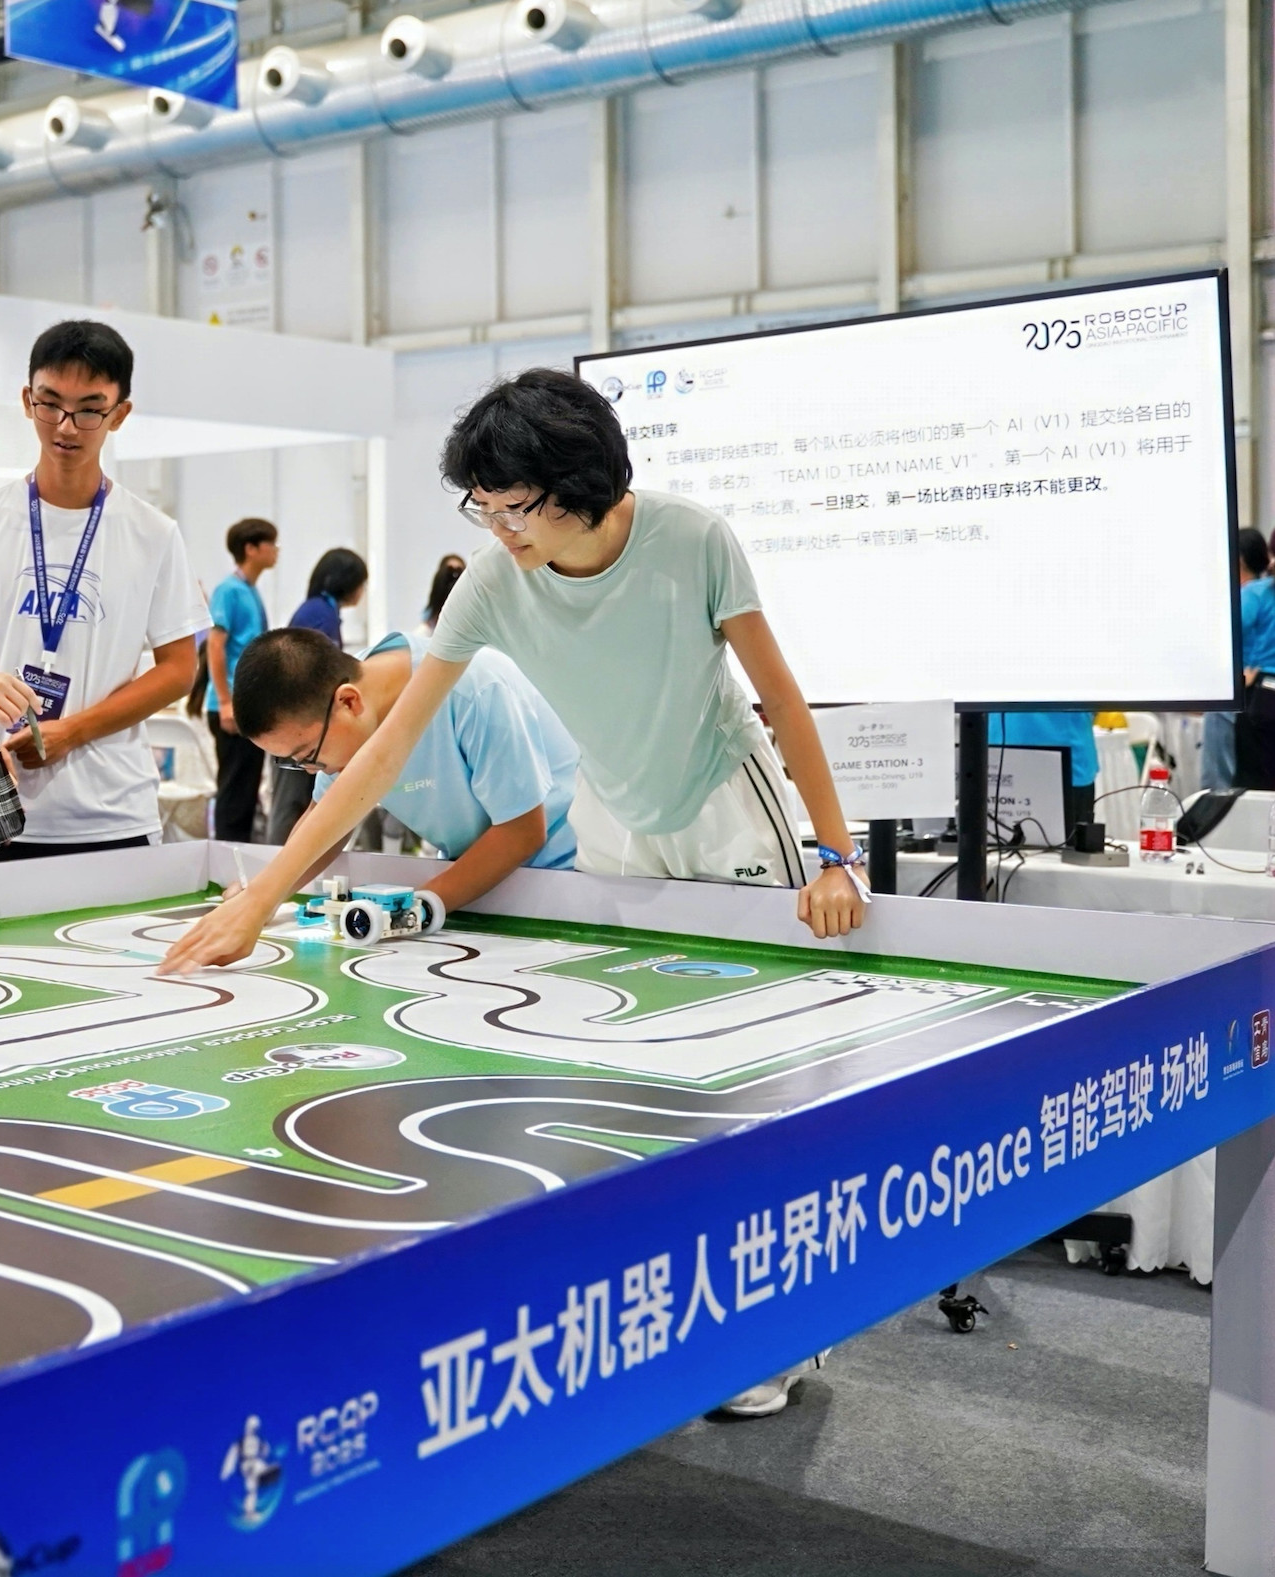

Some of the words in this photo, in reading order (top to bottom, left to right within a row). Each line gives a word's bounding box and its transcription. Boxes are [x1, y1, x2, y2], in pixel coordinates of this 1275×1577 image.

[1085, 303, 1187, 326] ROBOCUP
[1022, 319, 1081, 350] 2025
[1086, 317, 1188, 341] ASIA-PACIFIC
[625, 422, 678, 440] 提交程序
[832, 761, 862, 771] GAME
[865, 759, 908, 769] STATION
[917, 758, 923, 767] 3
[734, 865, 767, 878] FILA
[202, 1026, 292, 1047] CoSpace
[222, 1050, 361, 1083] RoboCup
[243, 1146, 284, 1158] 4
[418, 1173, 868, 1460] 亚太机器人世界杯
[878, 1126, 1031, 1240] CoSpace
[1039, 1054, 1154, 1174] 智能驾驶
[1160, 1031, 1210, 1113] 场地
[297, 1390, 379, 1454] RCAP
[310, 1432, 367, 1477] 2025
